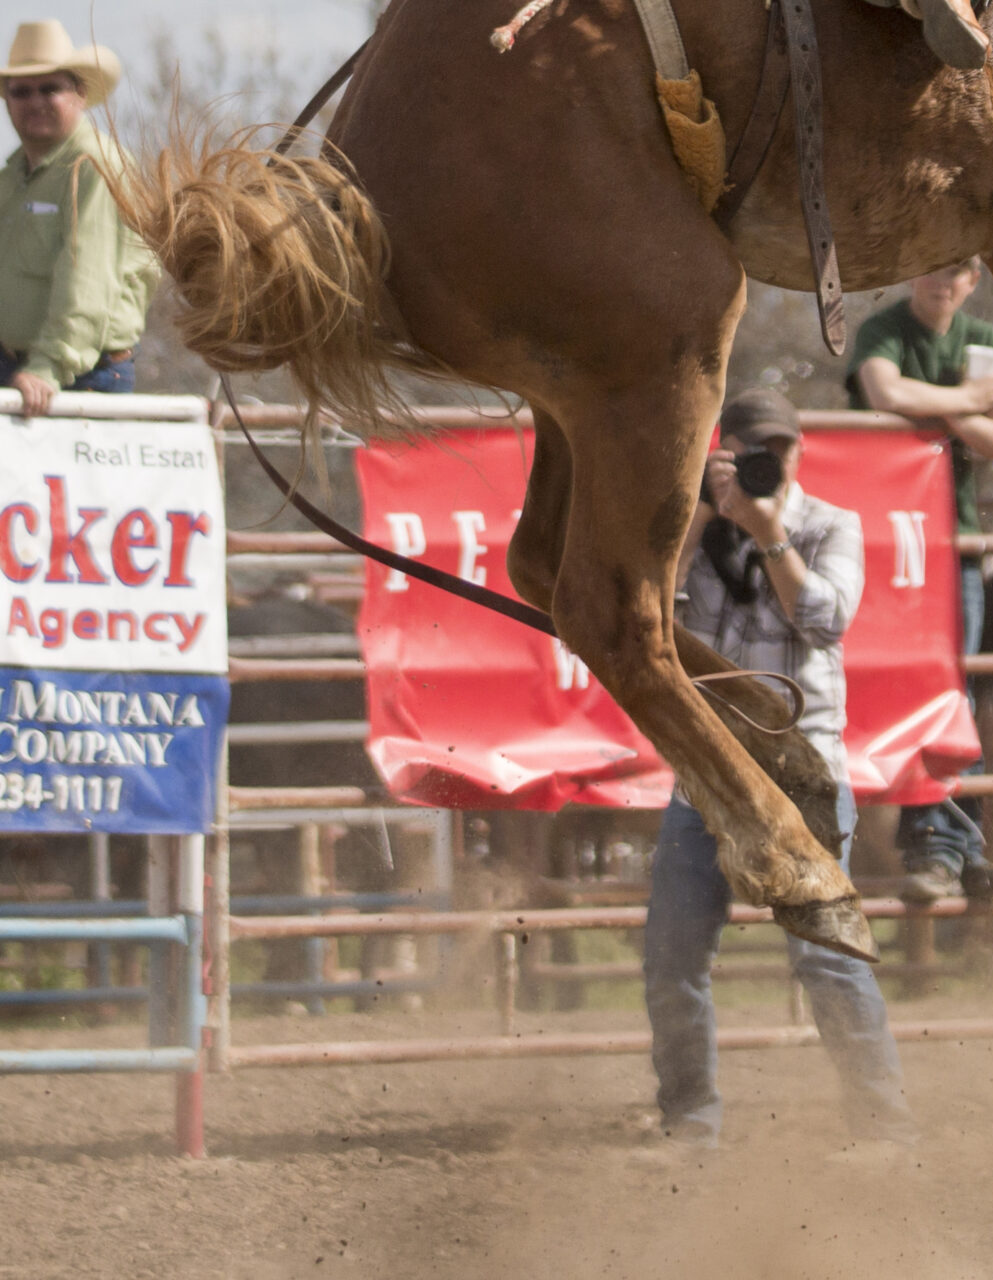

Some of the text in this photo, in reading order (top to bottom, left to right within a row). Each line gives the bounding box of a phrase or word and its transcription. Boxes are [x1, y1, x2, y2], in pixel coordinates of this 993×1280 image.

[75, 440, 131, 467] Real
[0, 474, 213, 588] cker
[7, 595, 207, 653] Agency
[8, 679, 206, 727] MONTANA
